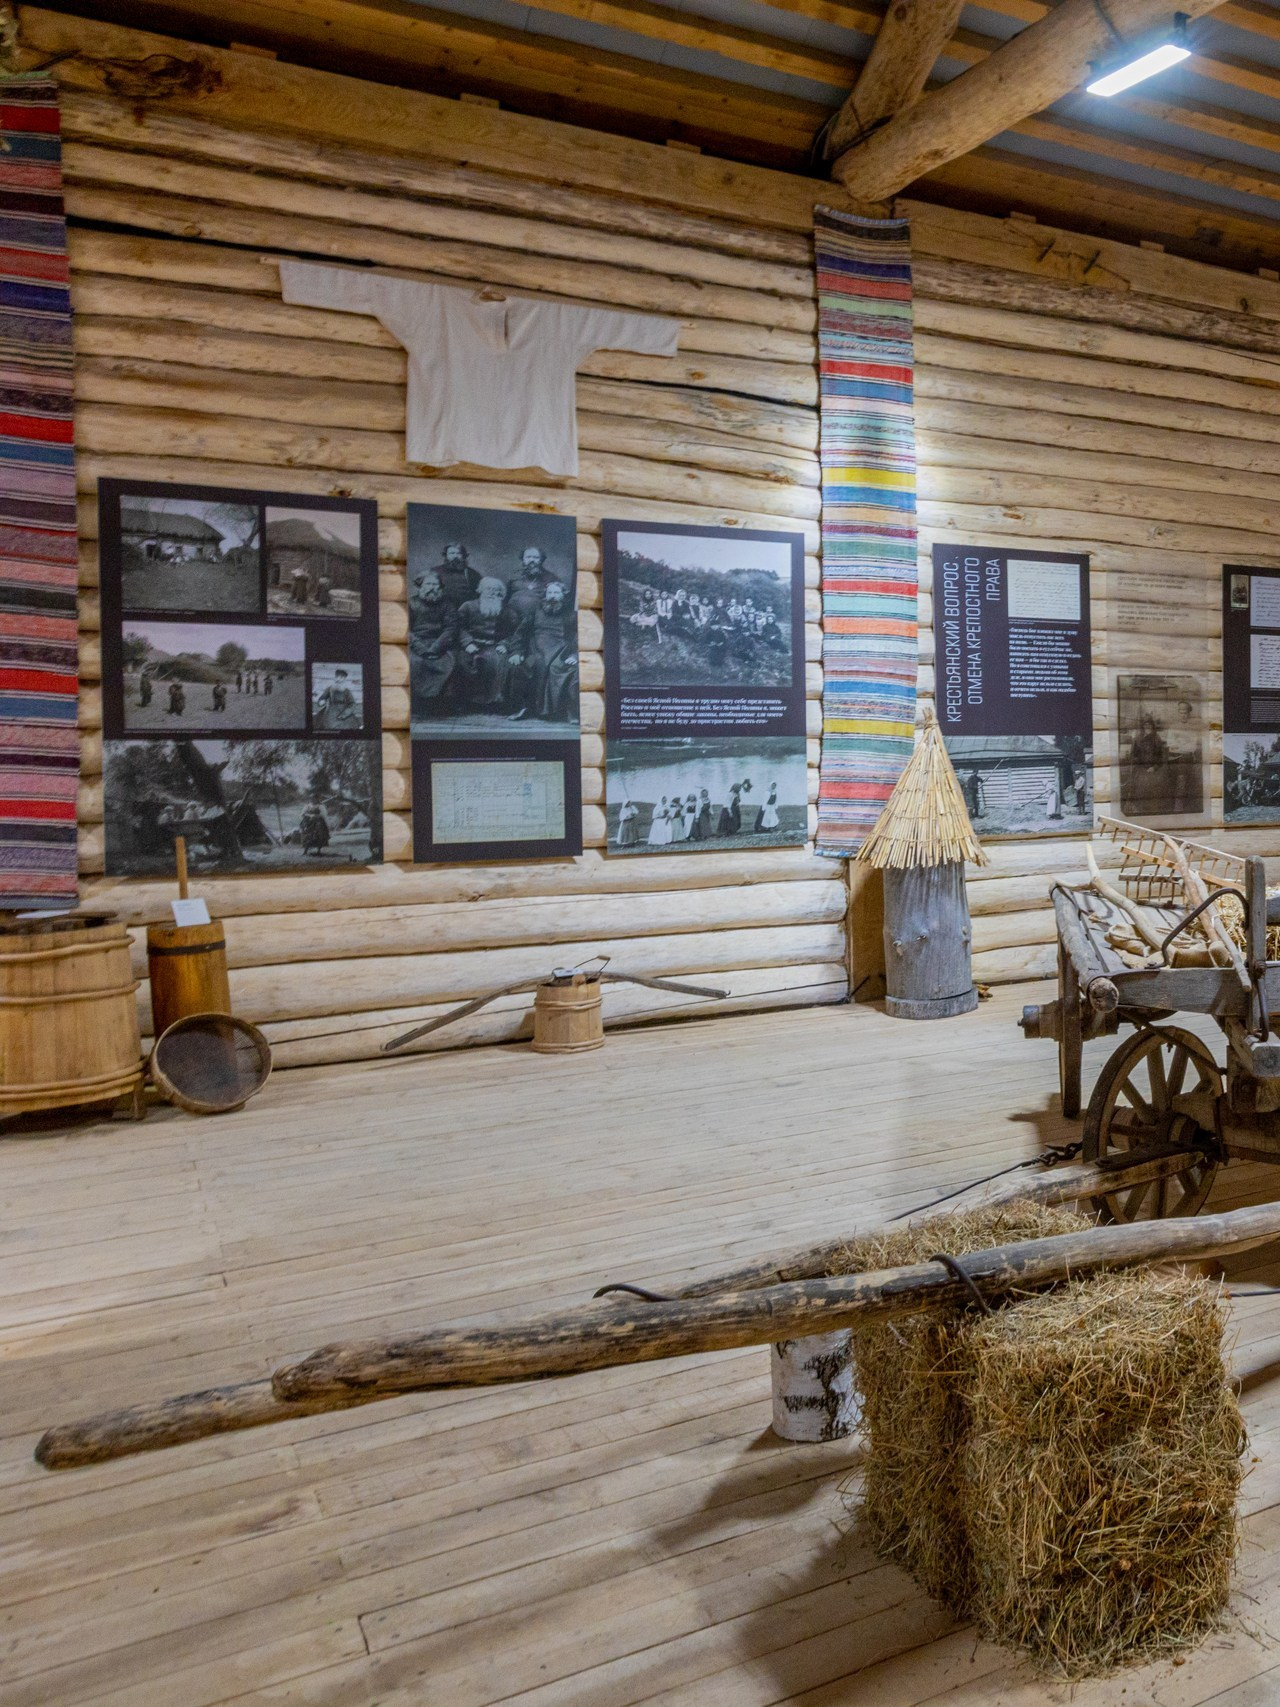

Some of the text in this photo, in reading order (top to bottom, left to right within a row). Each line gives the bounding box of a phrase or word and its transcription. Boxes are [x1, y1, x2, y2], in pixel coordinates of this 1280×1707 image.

[985, 558, 1001, 601] ПРАВА
[942, 621, 962, 722] КРЕСТЬЯНСКИЙ
[964, 557, 983, 705] ОТМЕНА КРЕПОСТНОГО
